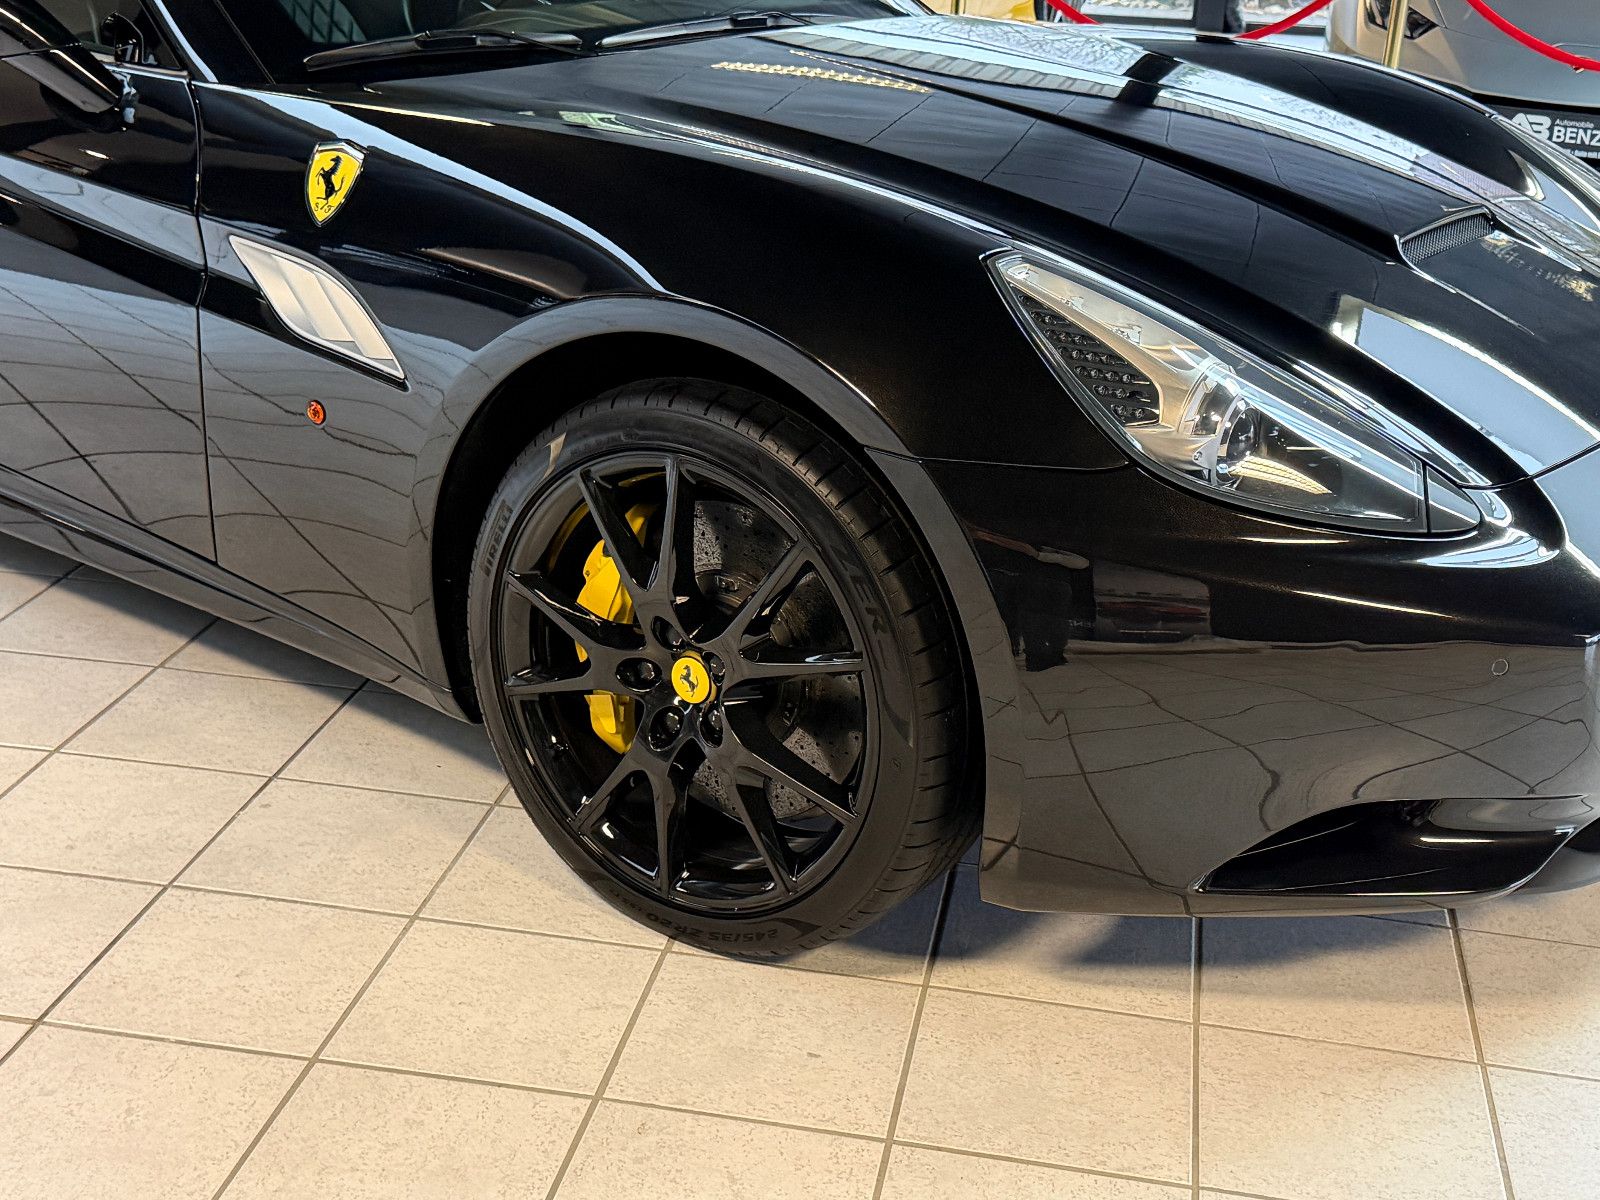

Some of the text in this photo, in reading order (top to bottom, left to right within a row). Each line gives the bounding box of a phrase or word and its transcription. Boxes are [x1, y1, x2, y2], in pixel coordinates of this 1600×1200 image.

[1554, 119, 1595, 128] Automobile
[479, 499, 514, 577] PIRELLI
[707, 928, 779, 943] 245/35
